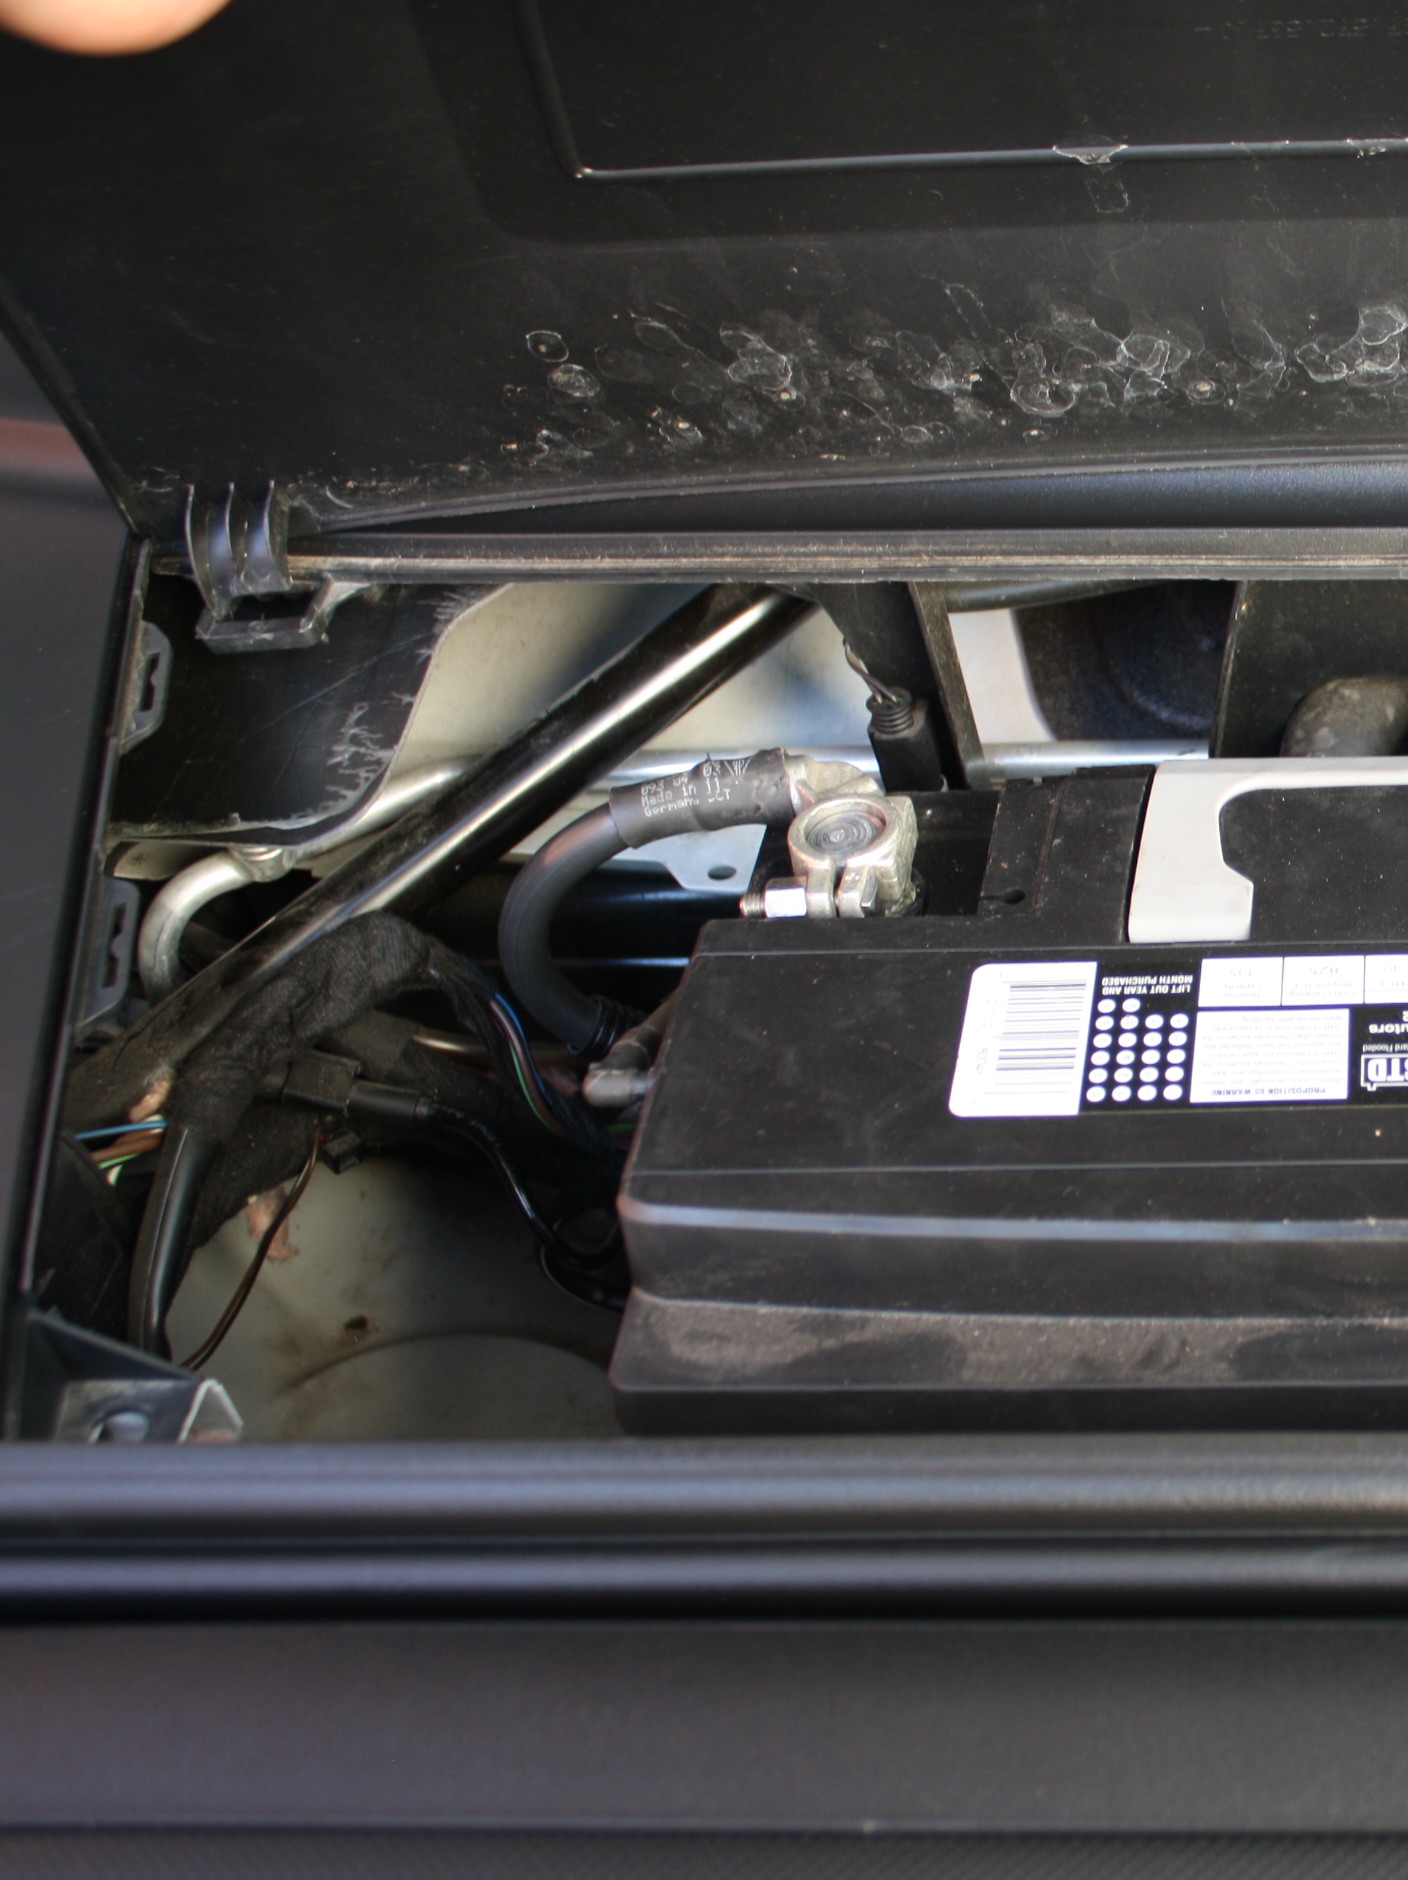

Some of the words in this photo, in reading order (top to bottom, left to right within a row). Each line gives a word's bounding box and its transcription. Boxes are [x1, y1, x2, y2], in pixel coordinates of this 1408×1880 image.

[641, 790, 673, 807] Made
[682, 784, 696, 796] in
[1101, 976, 1157, 986] PURCHASED
[1159, 975, 1193, 984] MONTH
[1102, 986, 1122, 995] AND
[1123, 986, 1148, 994] YEAR
[1150, 985, 1169, 994] OUT
[1170, 984, 1191, 993] LIFT
[1362, 1043, 1393, 1053] Flooded
